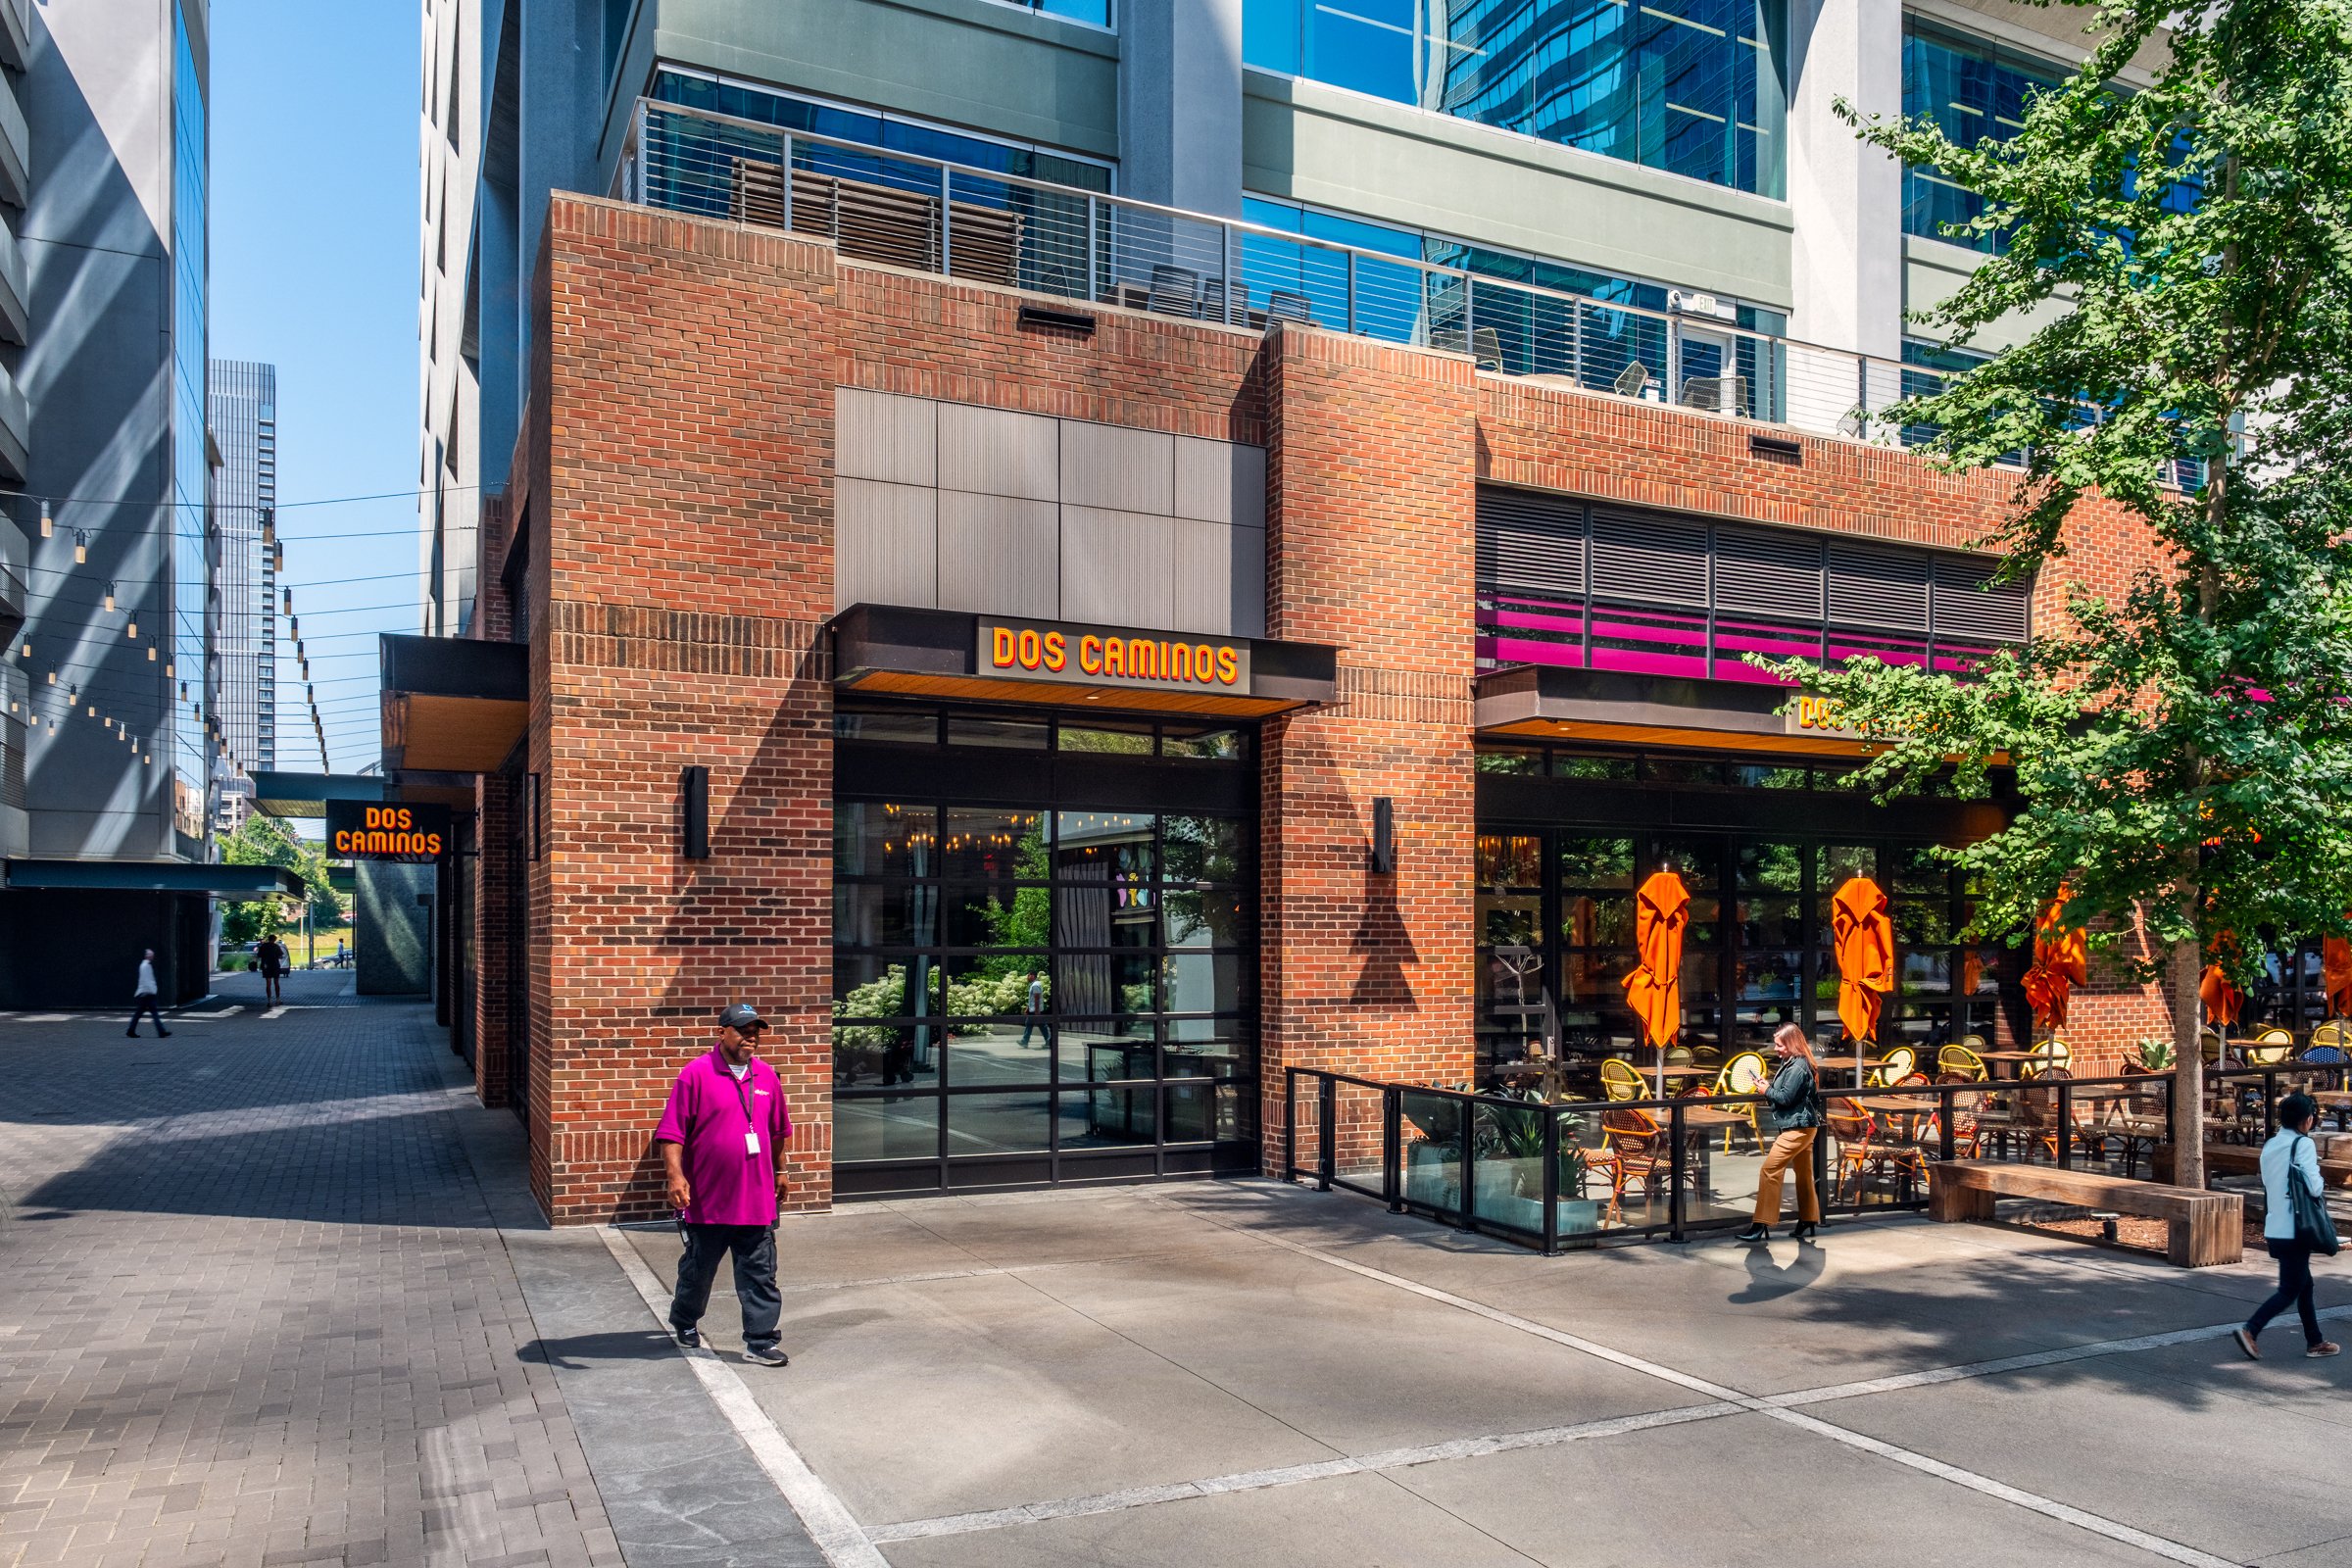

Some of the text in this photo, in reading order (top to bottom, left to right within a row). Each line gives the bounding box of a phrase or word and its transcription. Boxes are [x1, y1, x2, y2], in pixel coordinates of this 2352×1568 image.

[1699, 296, 1714, 313] EXIT
[993, 626, 1239, 685] DOS CAMINOS
[366, 807, 413, 830] DOS
[335, 830, 442, 856] CAMINOS
